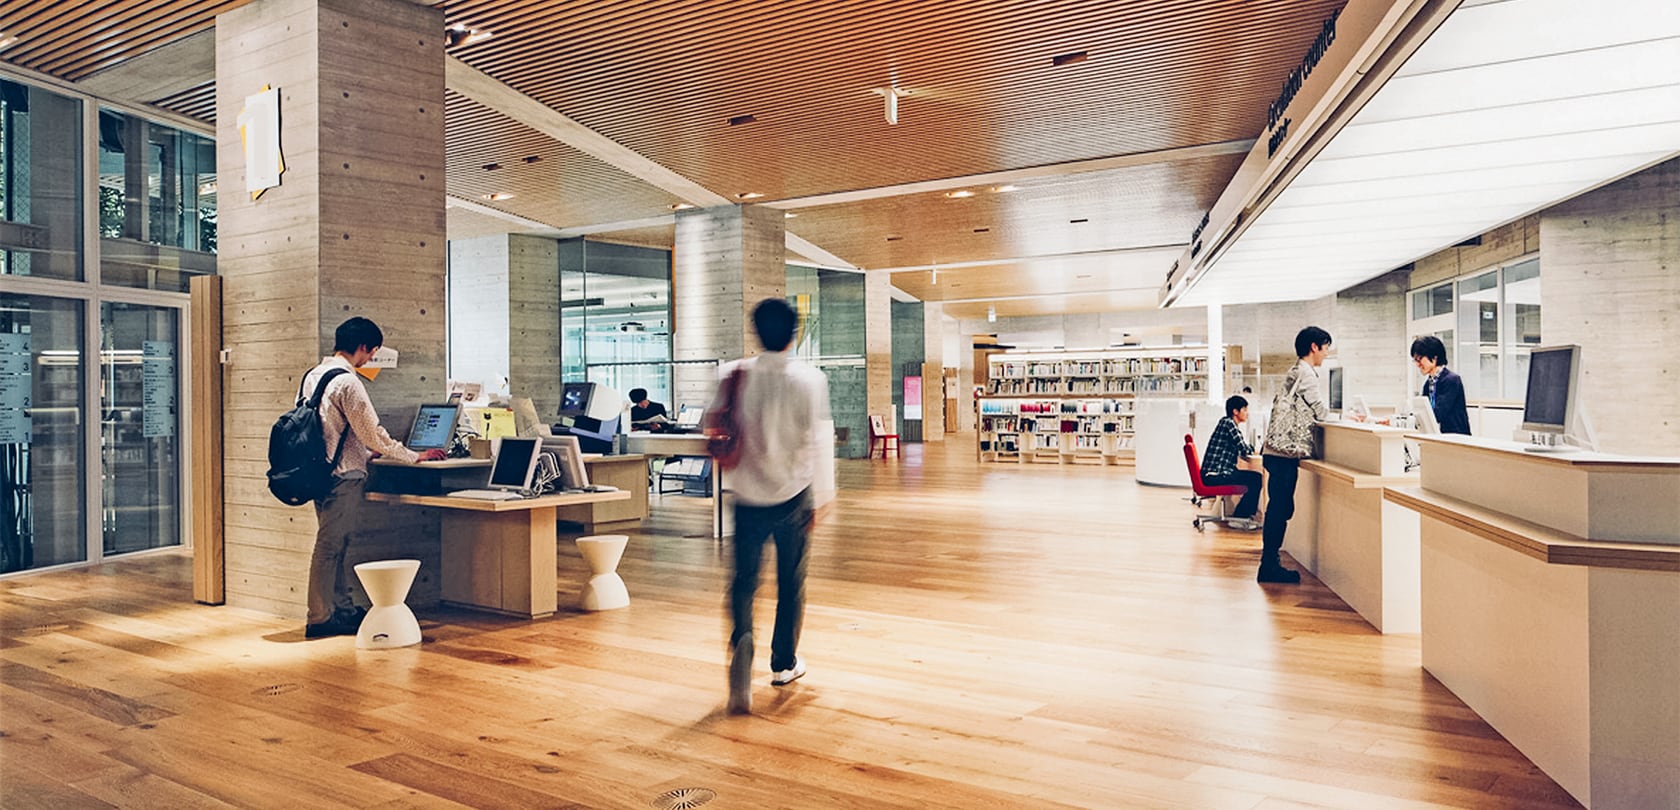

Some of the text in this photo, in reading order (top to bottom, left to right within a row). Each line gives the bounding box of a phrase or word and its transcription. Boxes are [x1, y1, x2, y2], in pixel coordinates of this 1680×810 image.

[1268, 66, 1302, 132] Circulation
[1303, 8, 1338, 80] counter
[22, 341, 29, 350] 4
[23, 362, 29, 371] 3
[23, 396, 30, 406] 2
[24, 431, 29, 441] 1
